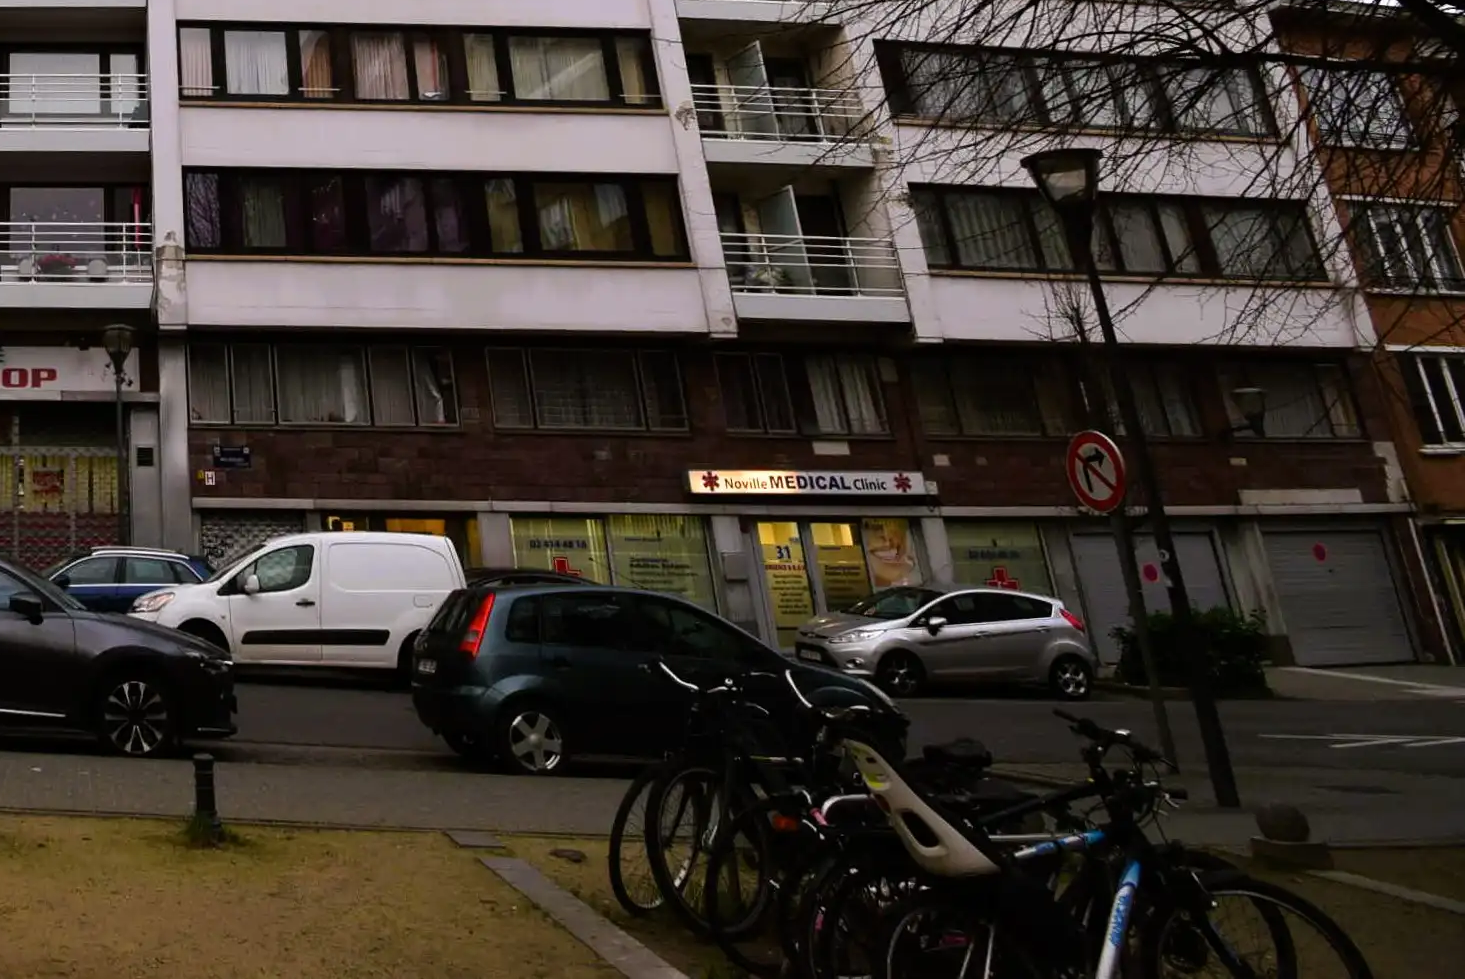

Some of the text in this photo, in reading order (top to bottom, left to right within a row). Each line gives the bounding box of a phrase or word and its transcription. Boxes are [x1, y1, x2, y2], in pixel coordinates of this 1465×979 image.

[206, 472, 214, 485] H
[724, 475, 888, 492] Noville MEDICAL Clinic
[776, 546, 791, 559] 31
